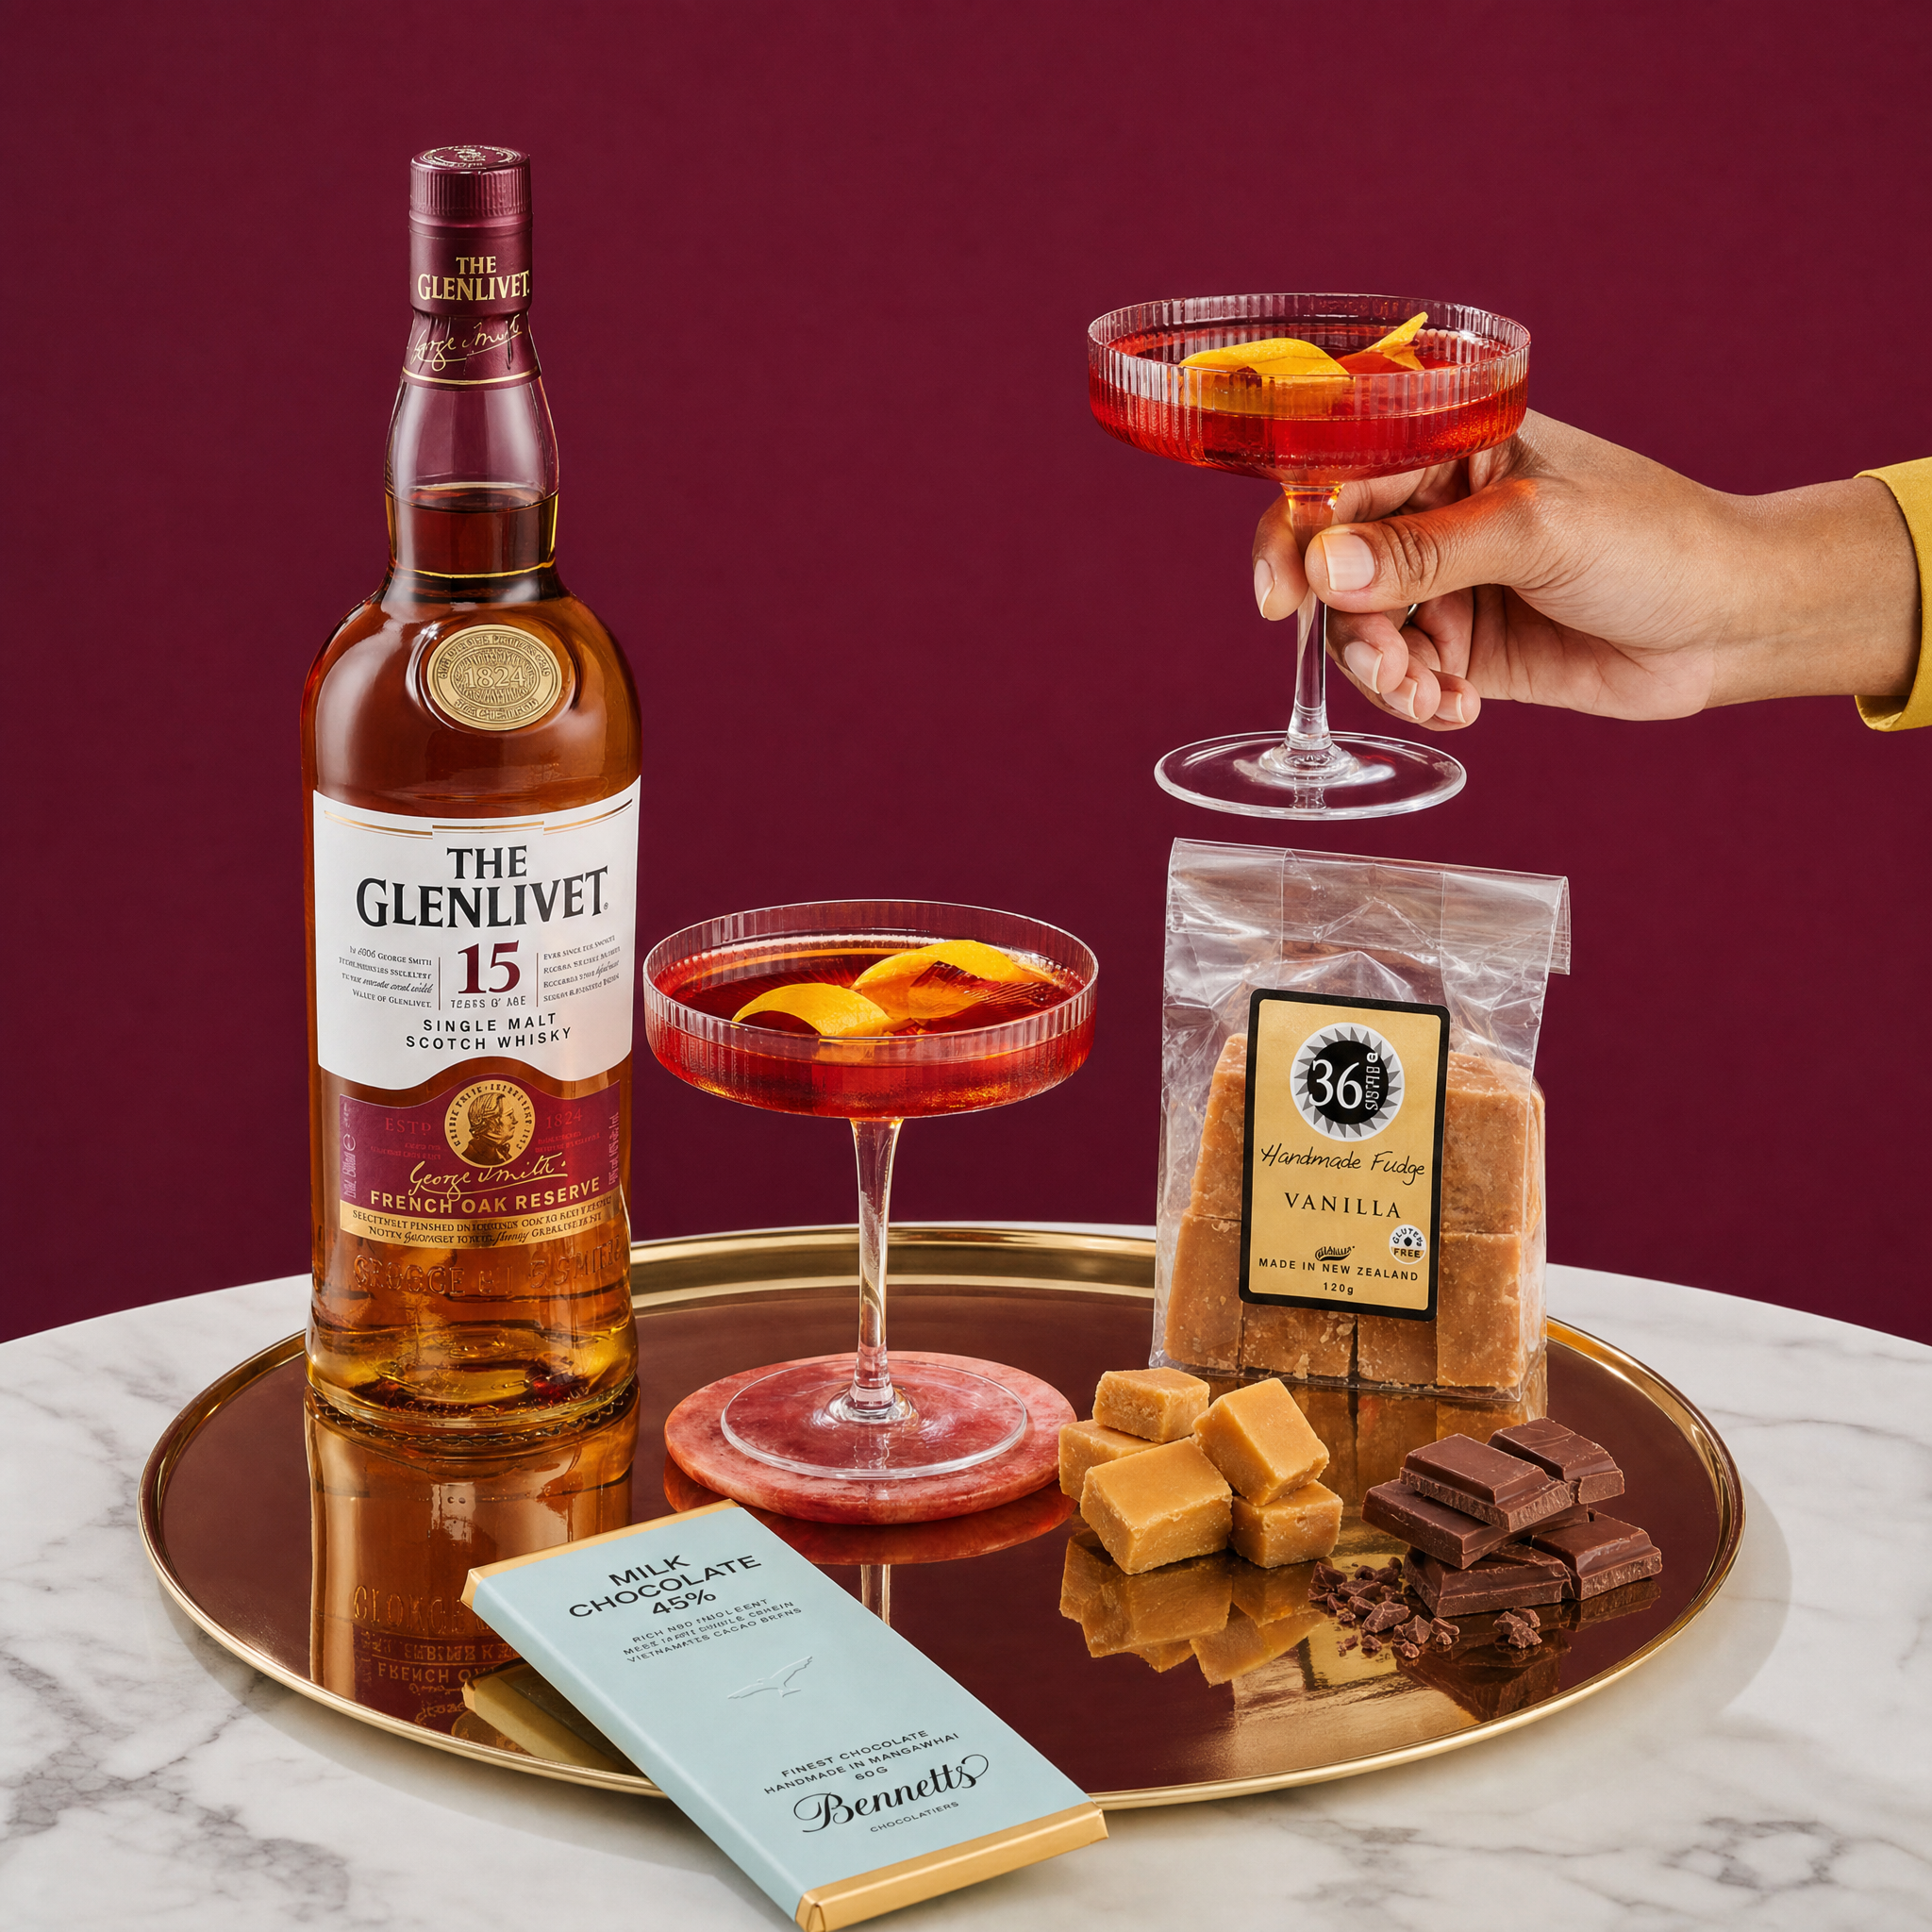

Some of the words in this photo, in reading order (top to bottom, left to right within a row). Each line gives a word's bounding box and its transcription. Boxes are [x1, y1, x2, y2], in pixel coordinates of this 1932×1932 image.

[456, 256, 497, 275] THE
[464, 665, 526, 690] 1824
[446, 844, 527, 880] THE
[458, 940, 521, 995] 15
[423, 1019, 496, 1033] SINGLE
[508, 1013, 557, 1030] MALT
[406, 1035, 487, 1050] SCOTCH
[497, 1027, 572, 1049] WHISKY
[1307, 1058, 1364, 1110] 36
[546, 1108, 583, 1129] 1824
[1260, 1142, 1362, 1170] Handmade
[1370, 1150, 1425, 1187] Fudge
[370, 1190, 453, 1214] FRENCH
[460, 1196, 508, 1214] OAK
[515, 1176, 600, 1210] RESERVE
[1284, 1191, 1402, 1219] VANILLA
[1393, 1248, 1421, 1258] FREE
[1258, 1257, 1296, 1271] MADE
[1302, 1261, 1316, 1272] IN
[1322, 1263, 1351, 1274] NEW
[1357, 1266, 1419, 1281] ZEALAND
[1323, 1282, 1355, 1296] 120g
[608, 1555, 691, 1587] MILK
[568, 1555, 762, 1618] CHOCOLATE
[652, 1589, 717, 1616] 45%
[632, 1629, 664, 1643] RICH
[713, 1621, 757, 1638] CACAO
[763, 1764, 846, 1794] HANDMADE
[848, 1760, 865, 1770] IN
[868, 1732, 959, 1765] MANGAWHAI
[780, 1757, 834, 1778] FINEST
[839, 1730, 929, 1760] CHOCOLATE
[854, 1766, 889, 1781] 60G
[869, 1801, 960, 1833] CHOCOLATIERS
